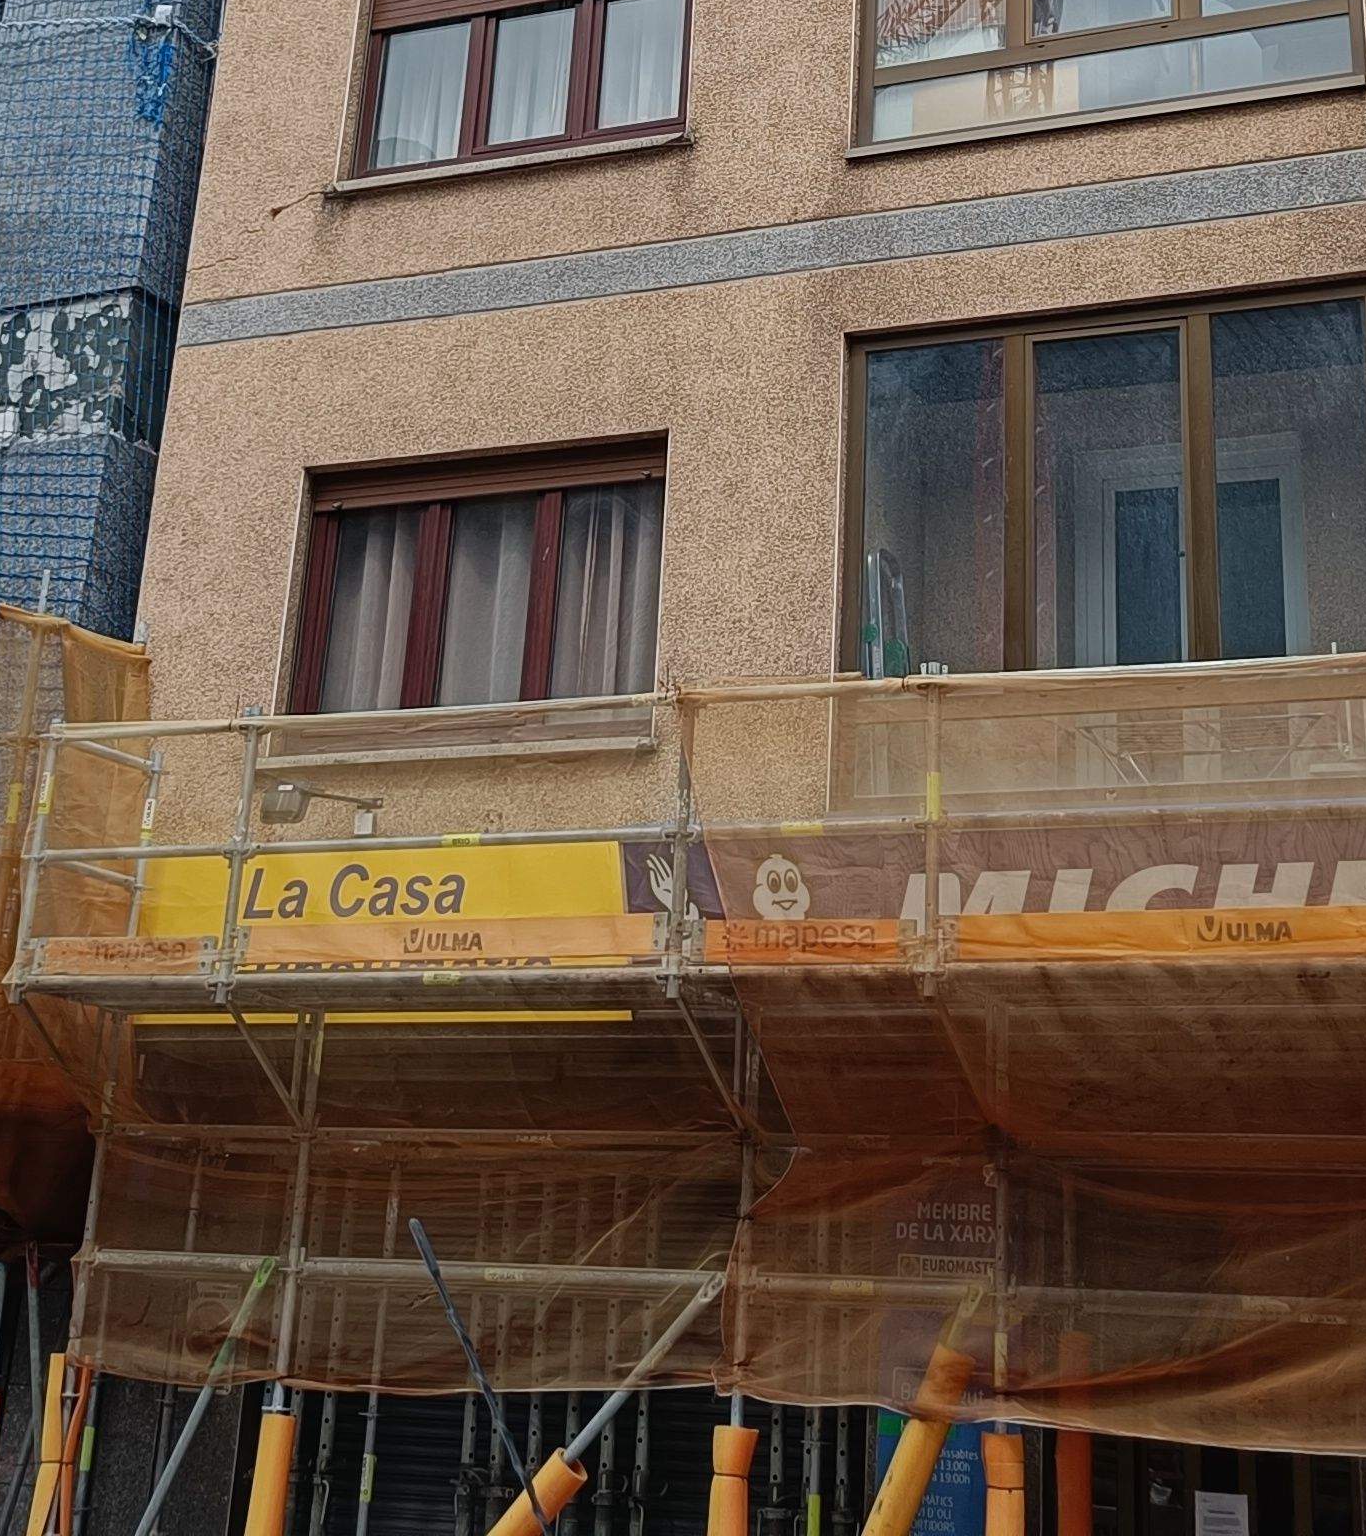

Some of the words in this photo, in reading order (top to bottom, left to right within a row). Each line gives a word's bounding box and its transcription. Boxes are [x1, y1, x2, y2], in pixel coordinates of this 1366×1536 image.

[243, 868, 309, 919] La
[329, 863, 467, 918] Casa
[755, 924, 876, 952] mapesa
[1226, 920, 1293, 941] ULMA
[428, 932, 483, 951] ULMA
[917, 1202, 992, 1222] MEMBRE
[896, 1222, 919, 1240] DE
[923, 1223, 945, 1242] LA
[949, 1224, 1013, 1243] XARX
[922, 1257, 996, 1275] EUROMAST
